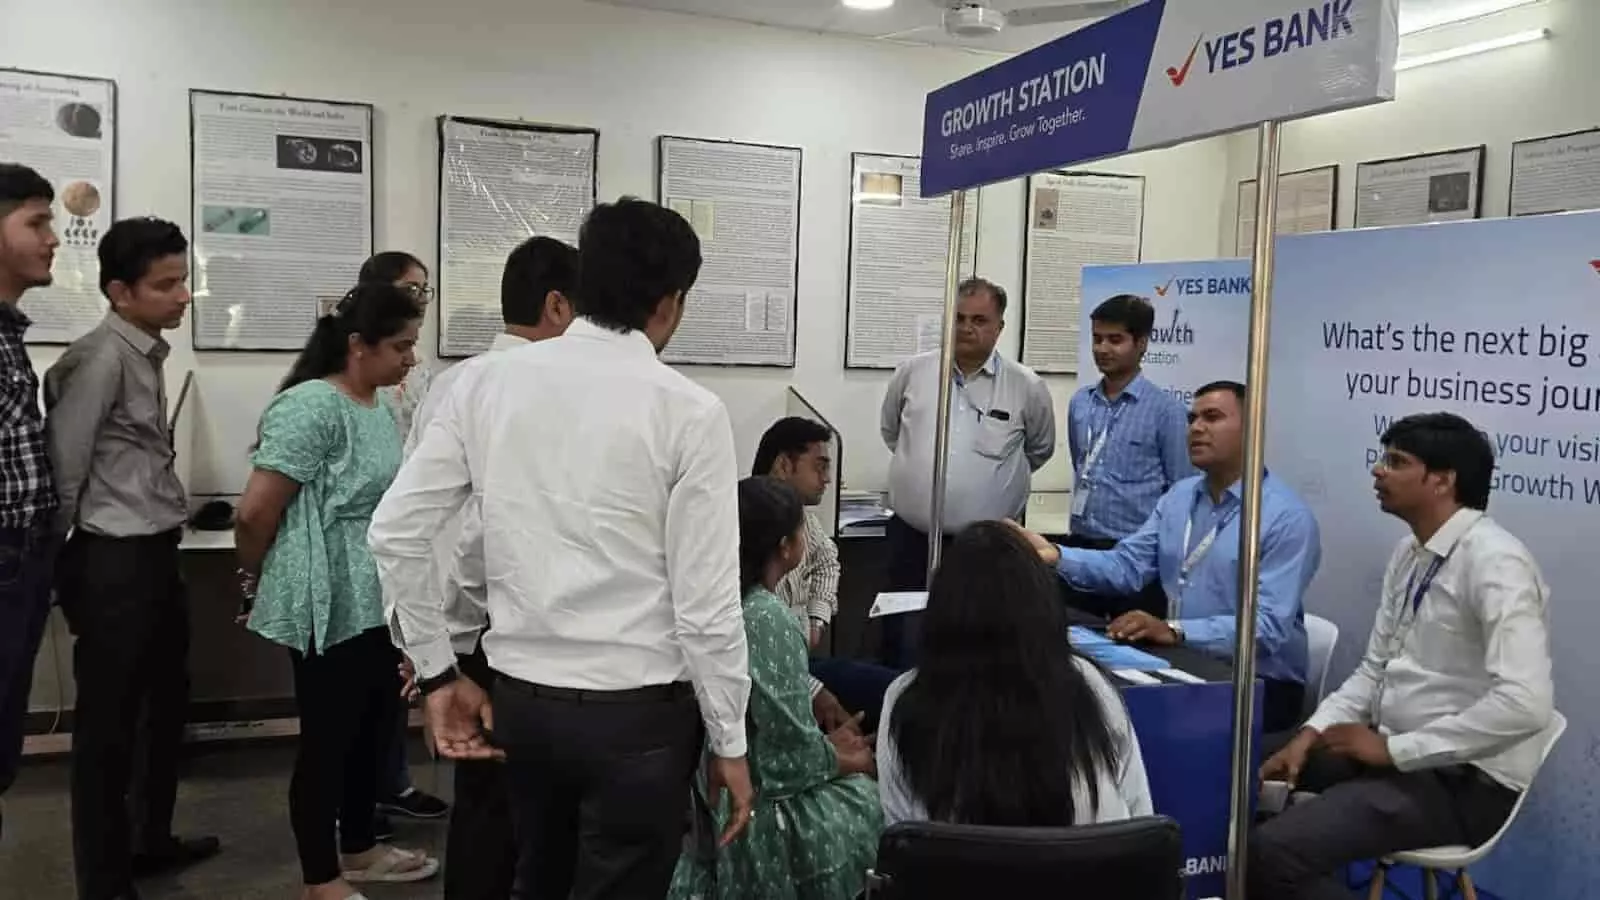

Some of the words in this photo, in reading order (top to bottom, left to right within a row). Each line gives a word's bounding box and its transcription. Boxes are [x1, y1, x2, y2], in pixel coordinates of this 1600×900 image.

[1204, 26, 1256, 74] YES
[1262, 0, 1353, 59] BANK
[941, 87, 1014, 137] GROWTH
[1018, 52, 1107, 112] STATION
[1008, 122, 1036, 142] Grow
[1036, 105, 1087, 136] Together.
[1175, 277, 1203, 296] YES
[1207, 275, 1251, 295] BANK
[1322, 320, 1405, 351] What's
[1411, 322, 1456, 353] the
[1463, 325, 1530, 357] next
[1538, 323, 1590, 368] big
[1345, 371, 1401, 400] your
[1406, 367, 1532, 407] business
[1495, 432, 1551, 458] your
